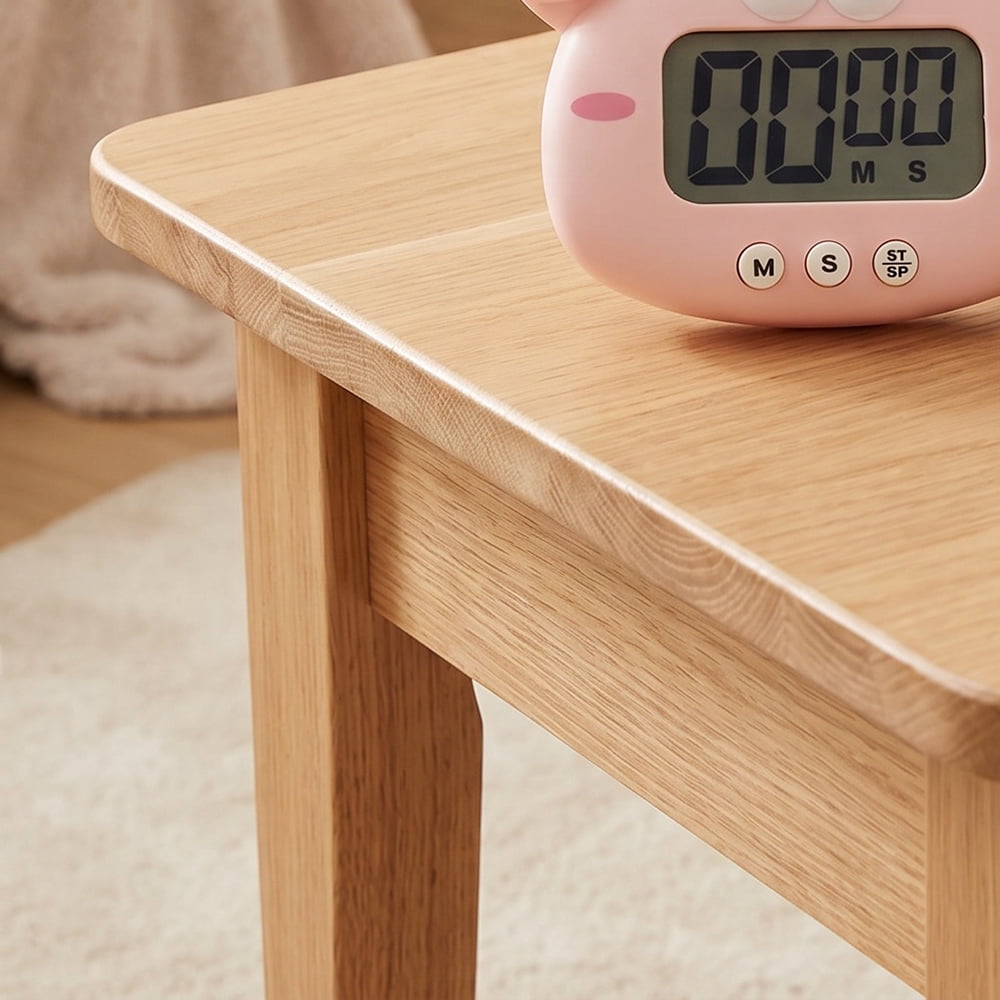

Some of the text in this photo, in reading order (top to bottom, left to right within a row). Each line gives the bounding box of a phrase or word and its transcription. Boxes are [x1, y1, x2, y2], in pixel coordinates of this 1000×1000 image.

[851, 160, 927, 184] M S
[821, 254, 838, 273] S
[886, 250, 907, 262] ST
[753, 258, 775, 277] M
[886, 266, 909, 278] SP
